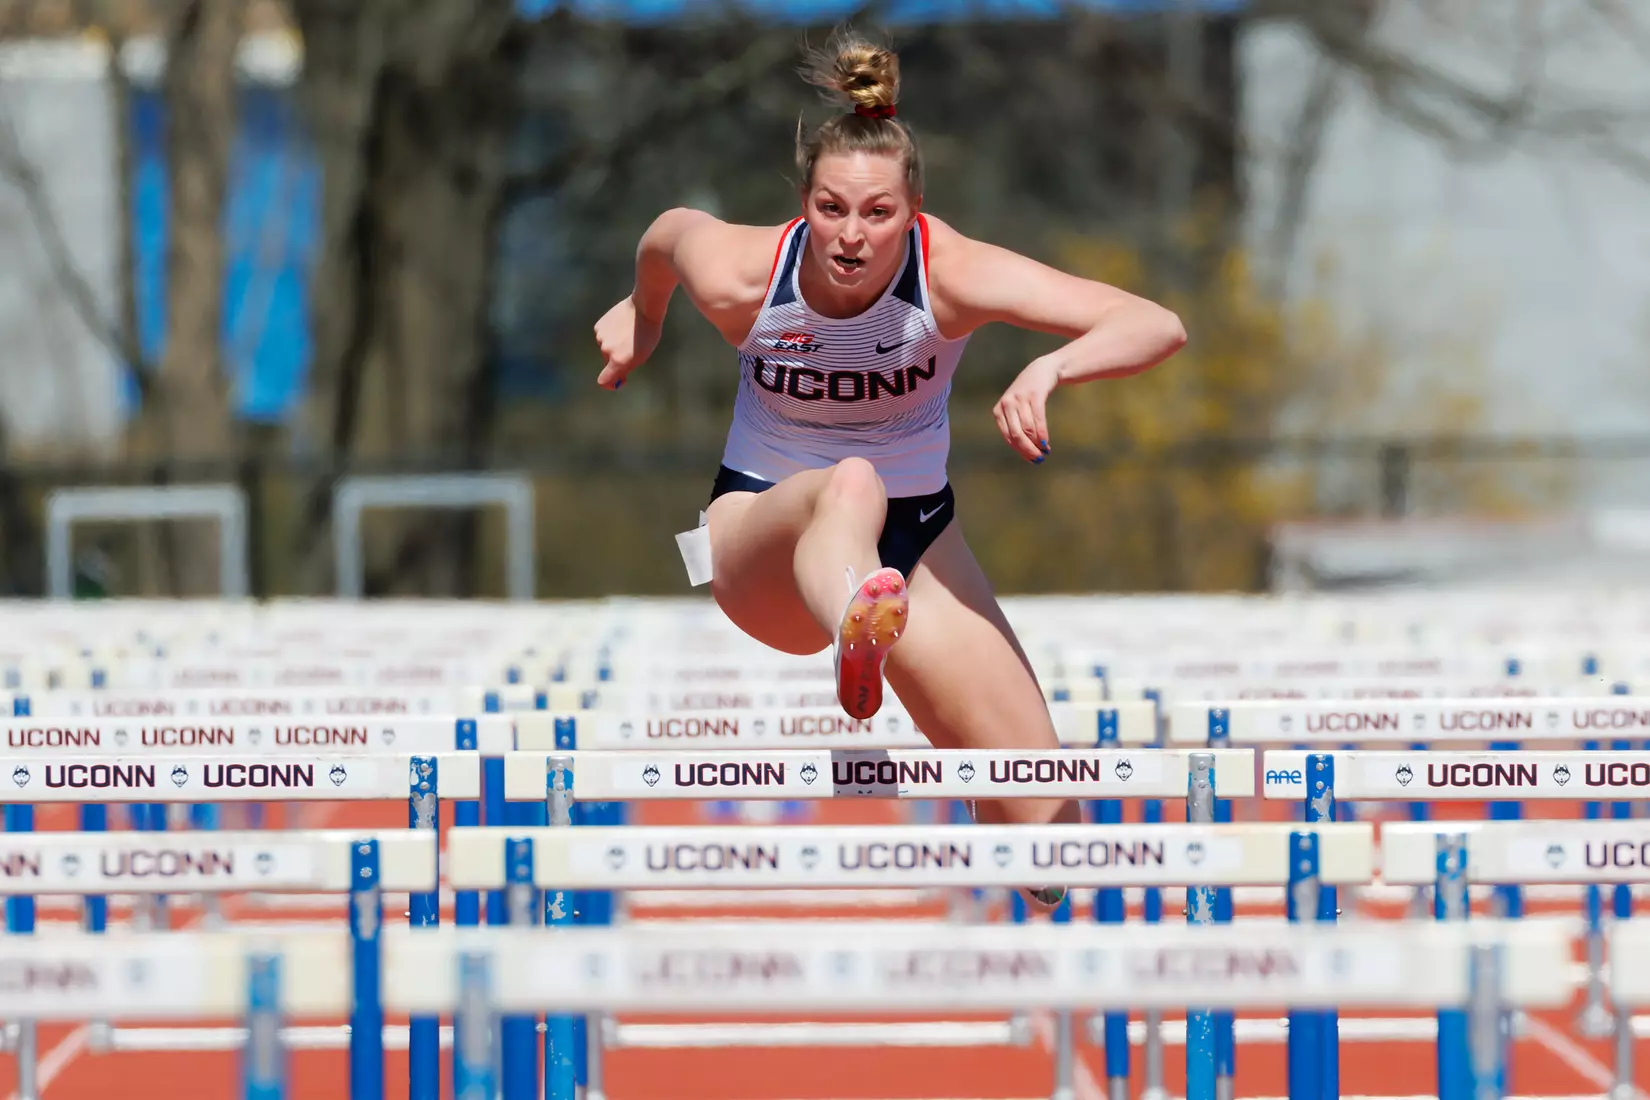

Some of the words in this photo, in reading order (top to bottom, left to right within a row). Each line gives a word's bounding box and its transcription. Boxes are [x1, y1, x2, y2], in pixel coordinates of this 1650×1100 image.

[773, 341, 824, 352] EAST
[780, 332, 815, 344] BIG
[753, 355, 937, 402] UCONN
[647, 718, 739, 738] UCONN
[780, 716, 873, 736] UCONN
[1306, 712, 1399, 733] UCONN
[1440, 711, 1532, 731] UCONN
[8, 728, 100, 747] UCONN
[142, 727, 234, 746] UCONN
[275, 726, 367, 746] UCONN
[45, 764, 155, 788] UCONN
[203, 764, 313, 788] UCONN
[675, 762, 785, 786] UCONN
[832, 761, 942, 785] UCONN
[990, 759, 1100, 783] UCONN
[1427, 763, 1537, 787] UCONN
[100, 850, 234, 878] UCONN
[646, 843, 780, 872] UCONN
[838, 842, 972, 870] UCONN
[1032, 841, 1165, 869] UCONN
